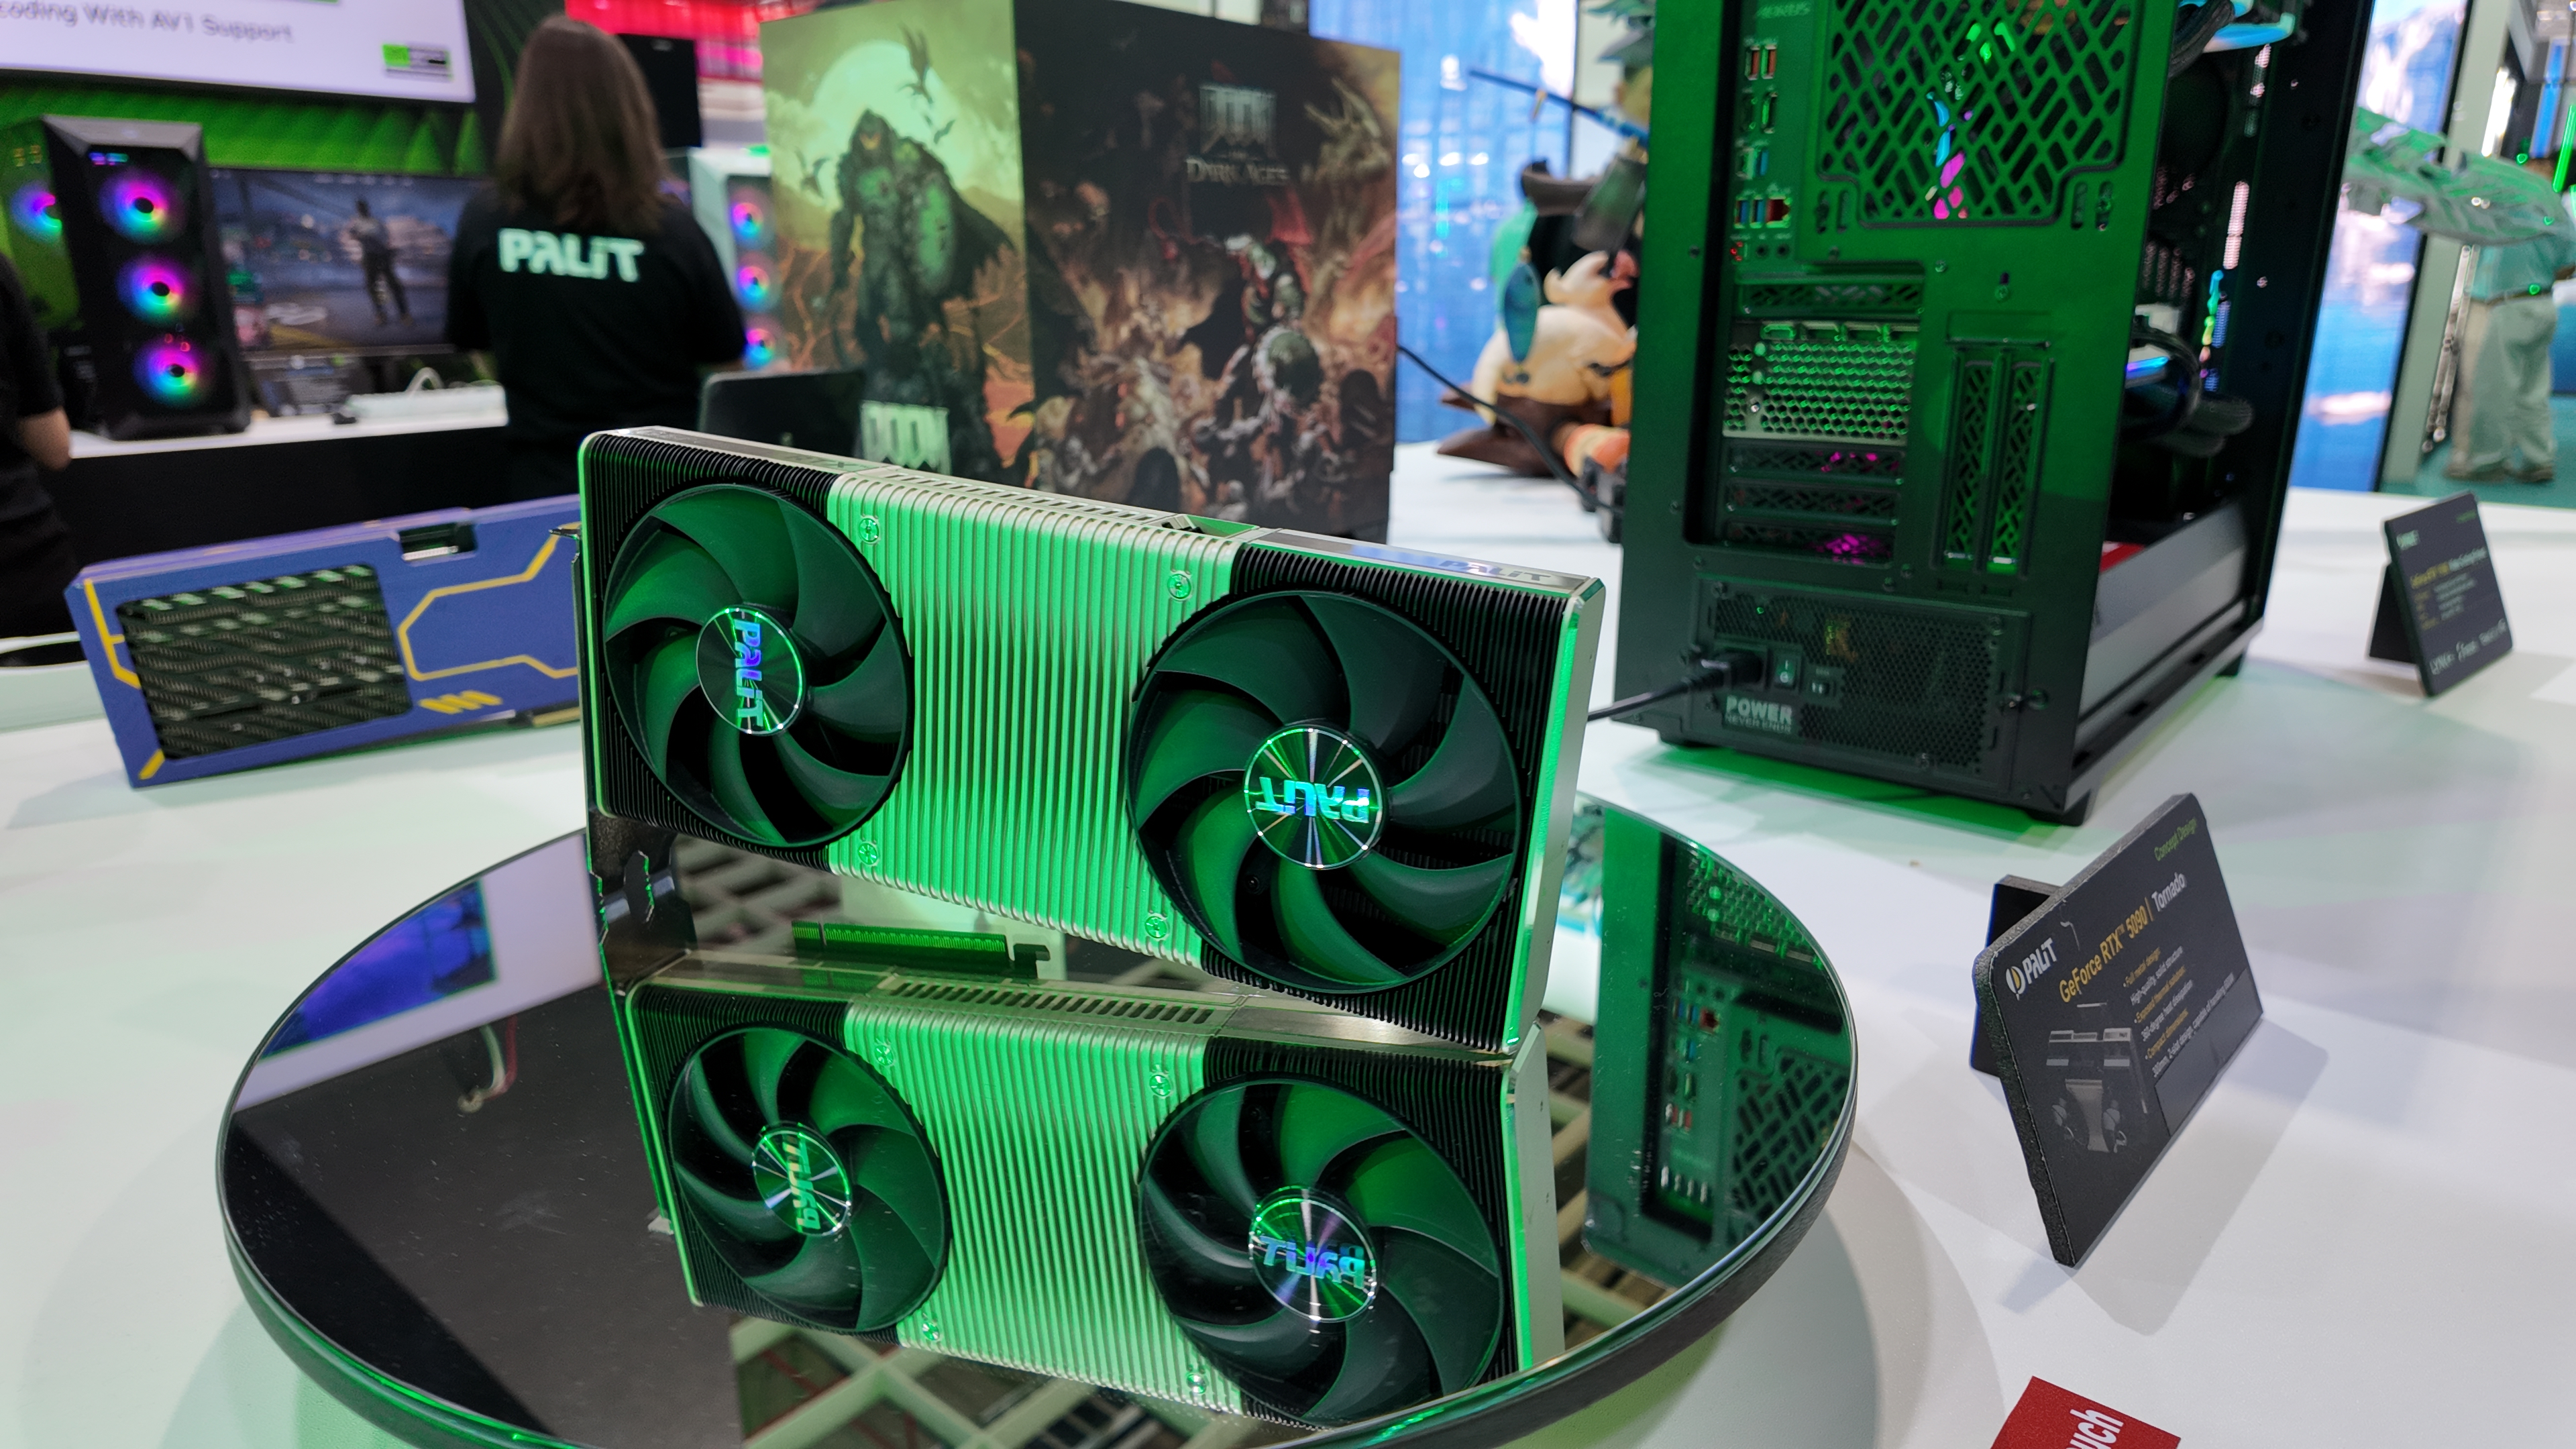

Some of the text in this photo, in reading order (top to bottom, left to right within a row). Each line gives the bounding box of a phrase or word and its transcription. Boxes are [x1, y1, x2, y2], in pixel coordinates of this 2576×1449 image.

[83, 3, 144, 29] With
[152, 10, 194, 33] AV1
[202, 15, 294, 44] Support
[1726, 695, 1792, 725] POWER
[2059, 955, 2102, 1002] GeForce
[2125, 904, 2148, 938] 5090
[2151, 872, 2188, 912] Tornado
[2066, 1409, 2124, 1449] uch
